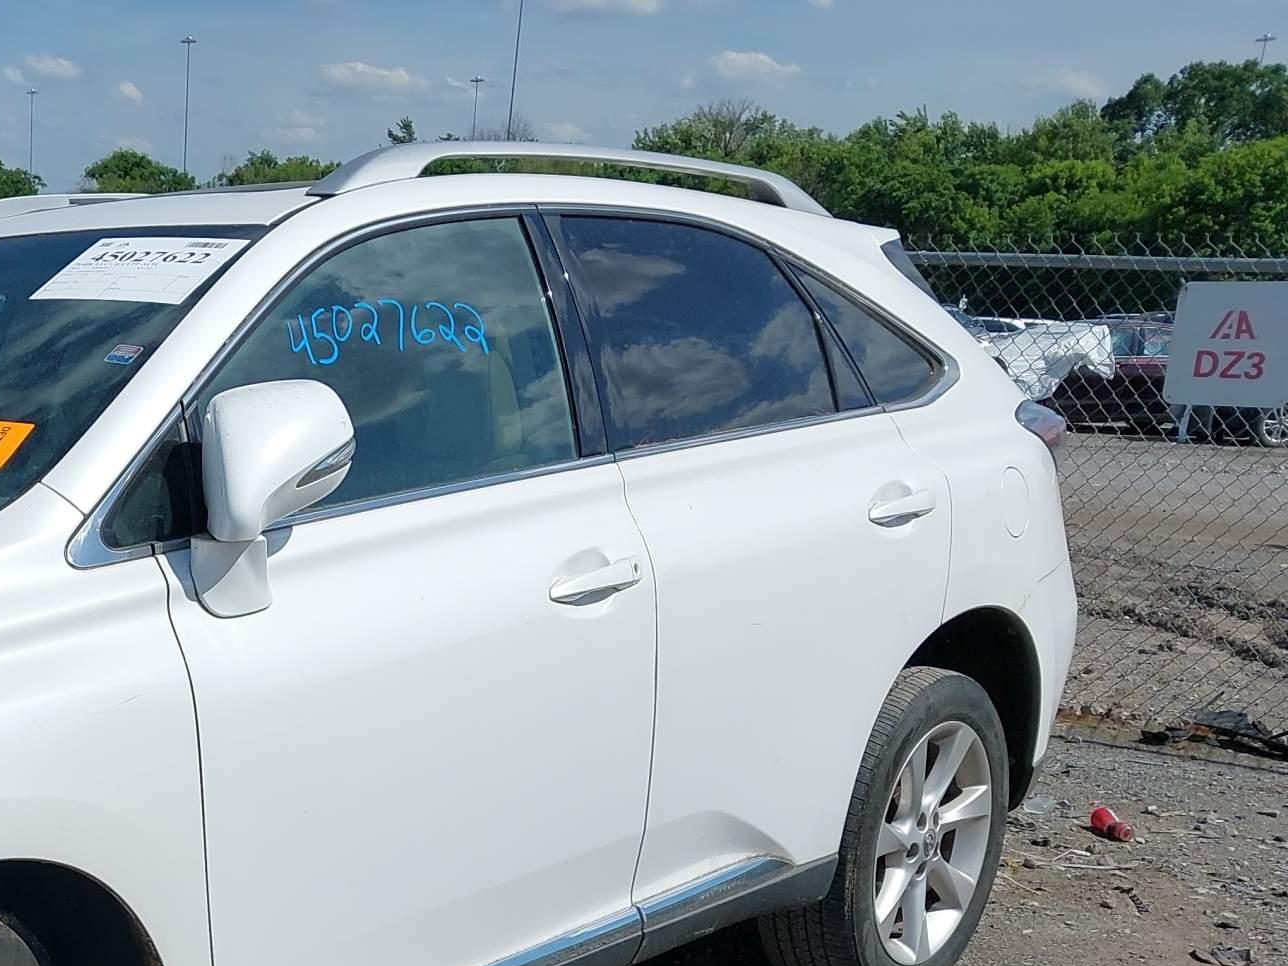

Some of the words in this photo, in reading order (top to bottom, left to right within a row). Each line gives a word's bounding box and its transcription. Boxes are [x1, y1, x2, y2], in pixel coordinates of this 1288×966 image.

[91, 250, 212, 264] 45027622
[287, 296, 490, 365] 45027622
[1193, 350, 1266, 380] DZ3
